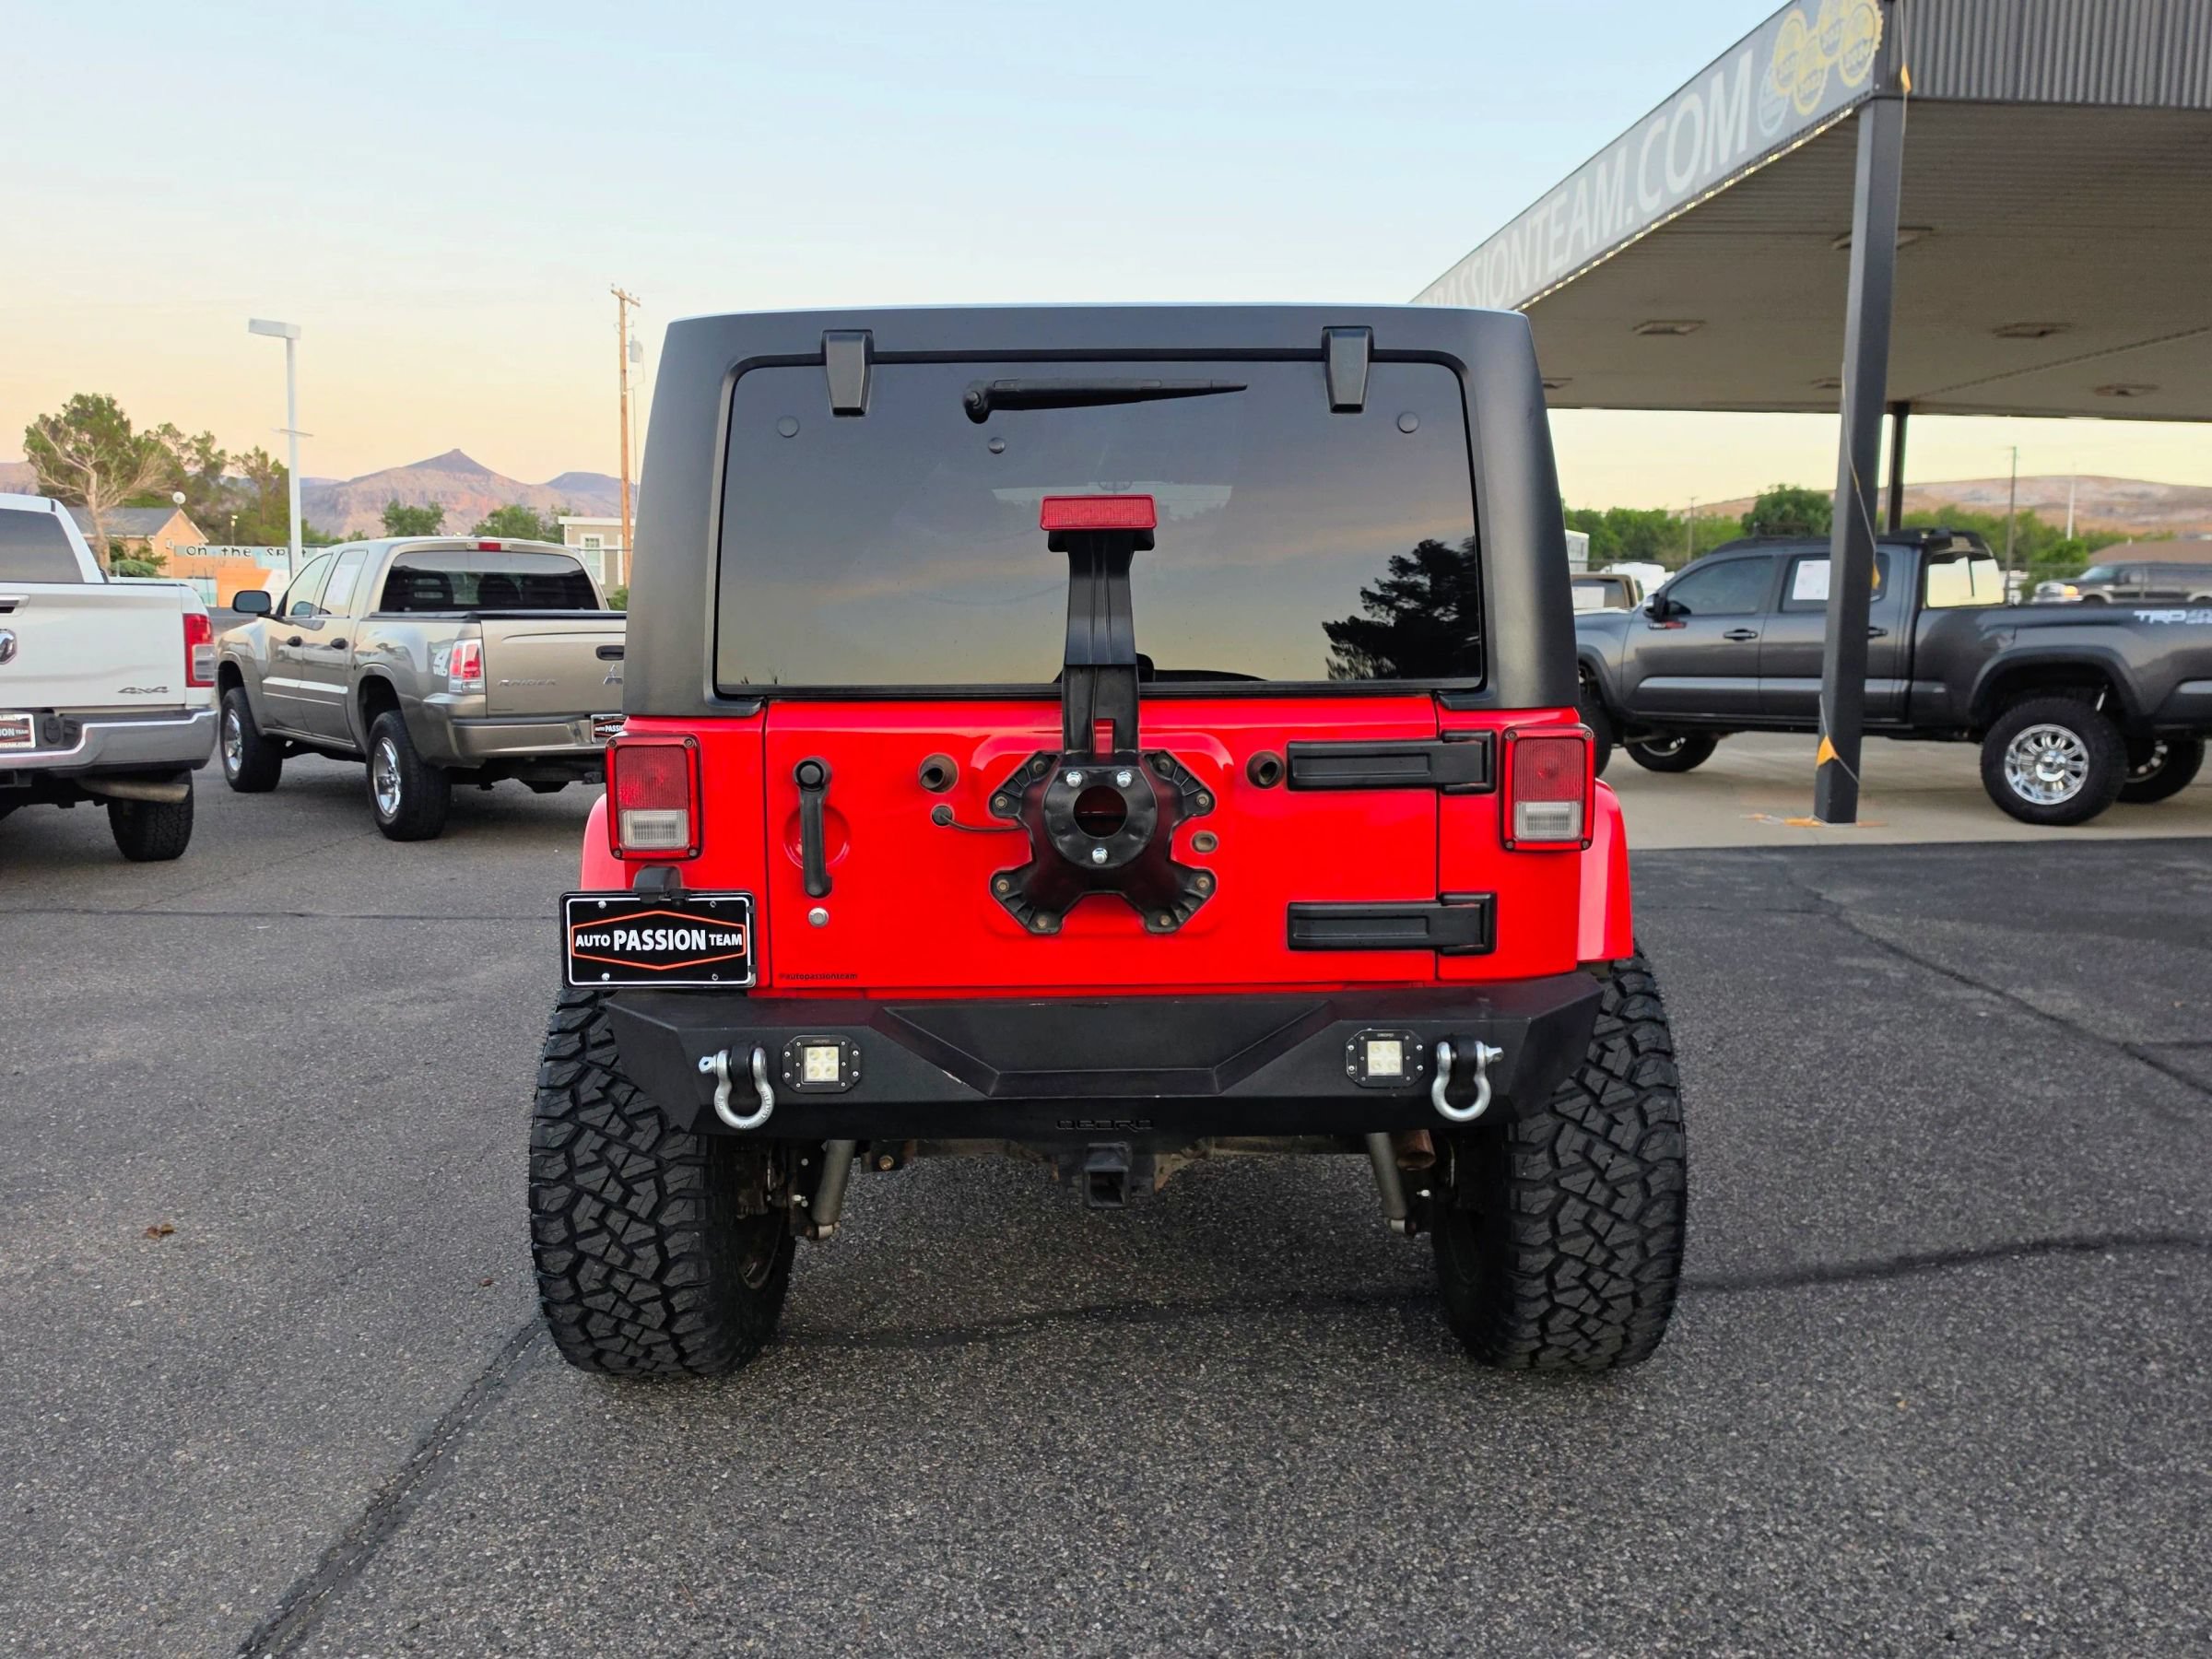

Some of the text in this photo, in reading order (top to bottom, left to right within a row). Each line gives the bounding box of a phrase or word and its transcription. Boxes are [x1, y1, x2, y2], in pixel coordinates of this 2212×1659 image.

[221, 547, 252, 558] the
[266, 547, 307, 558] spt
[498, 678, 557, 688] RAIDER
[575, 929, 743, 951] AUTO PASSION TEAM
